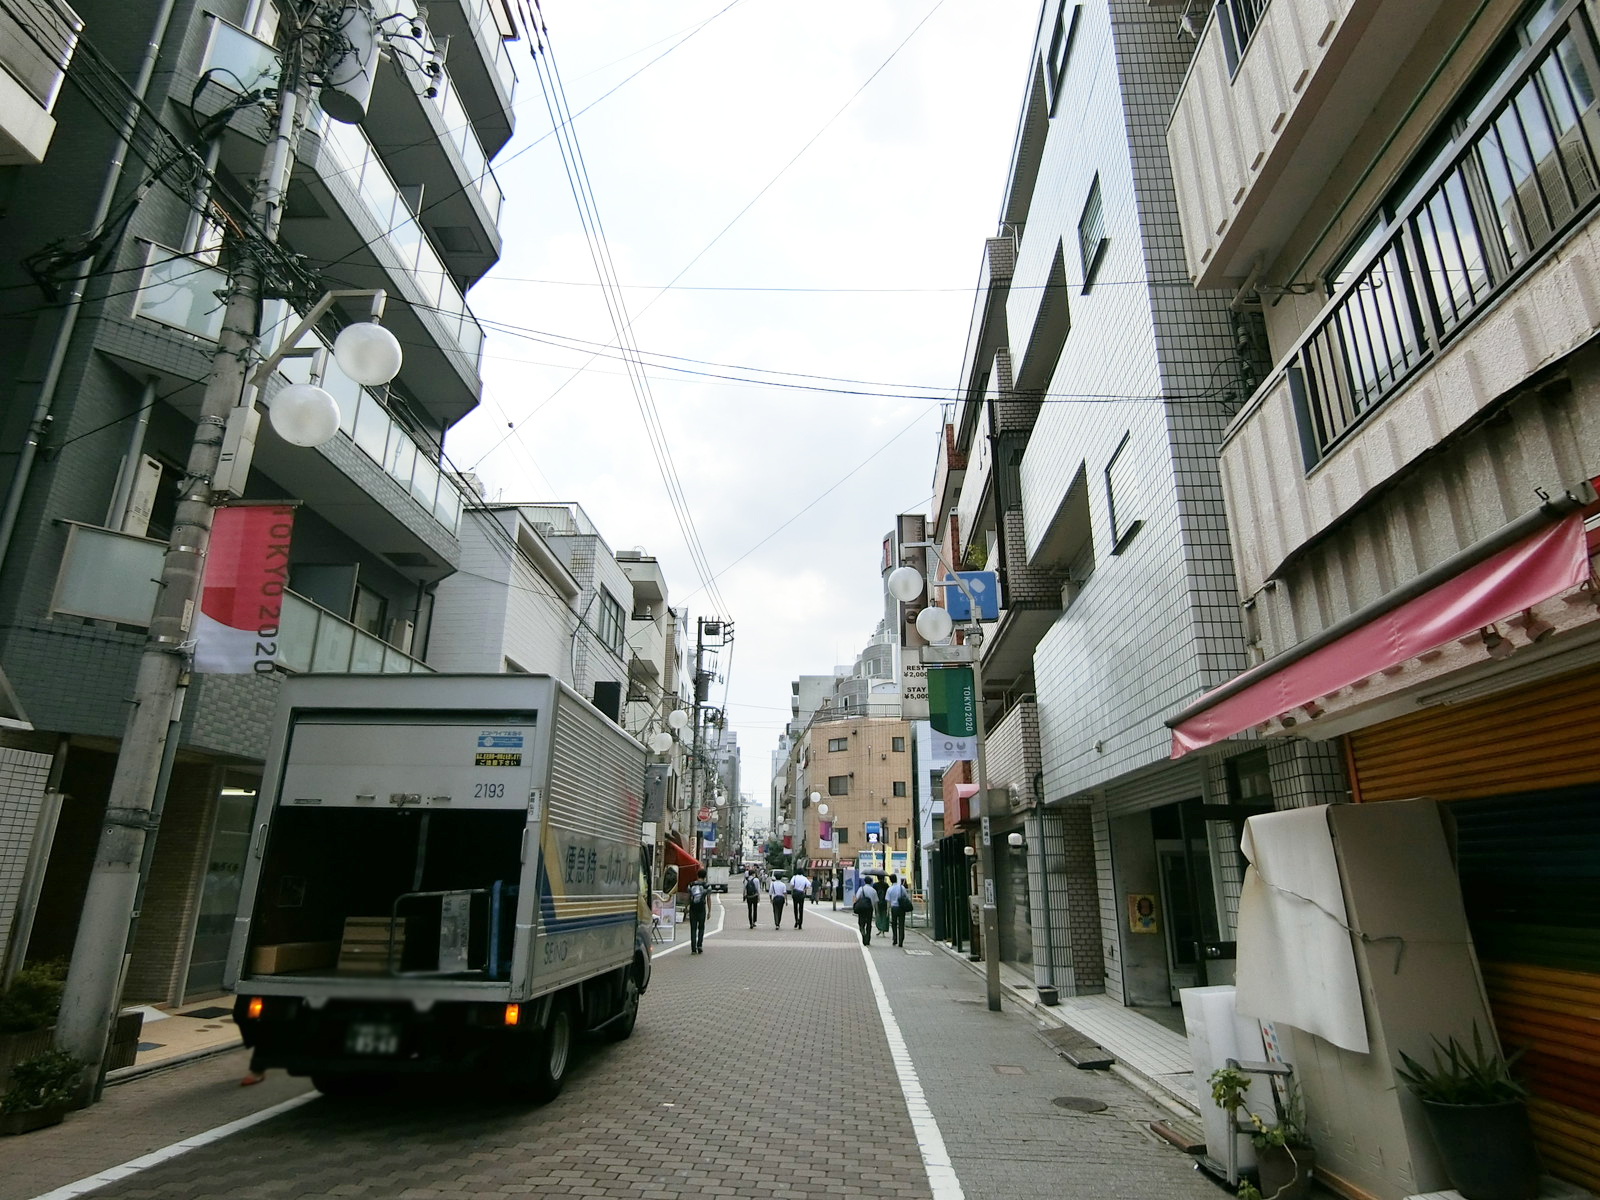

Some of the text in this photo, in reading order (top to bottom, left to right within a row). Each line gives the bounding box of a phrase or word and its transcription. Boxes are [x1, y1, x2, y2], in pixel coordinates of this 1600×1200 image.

[253, 507, 293, 674] TOKYO 2020
[963, 686, 974, 732] TOKYO 2020
[474, 783, 505, 798] 2193
